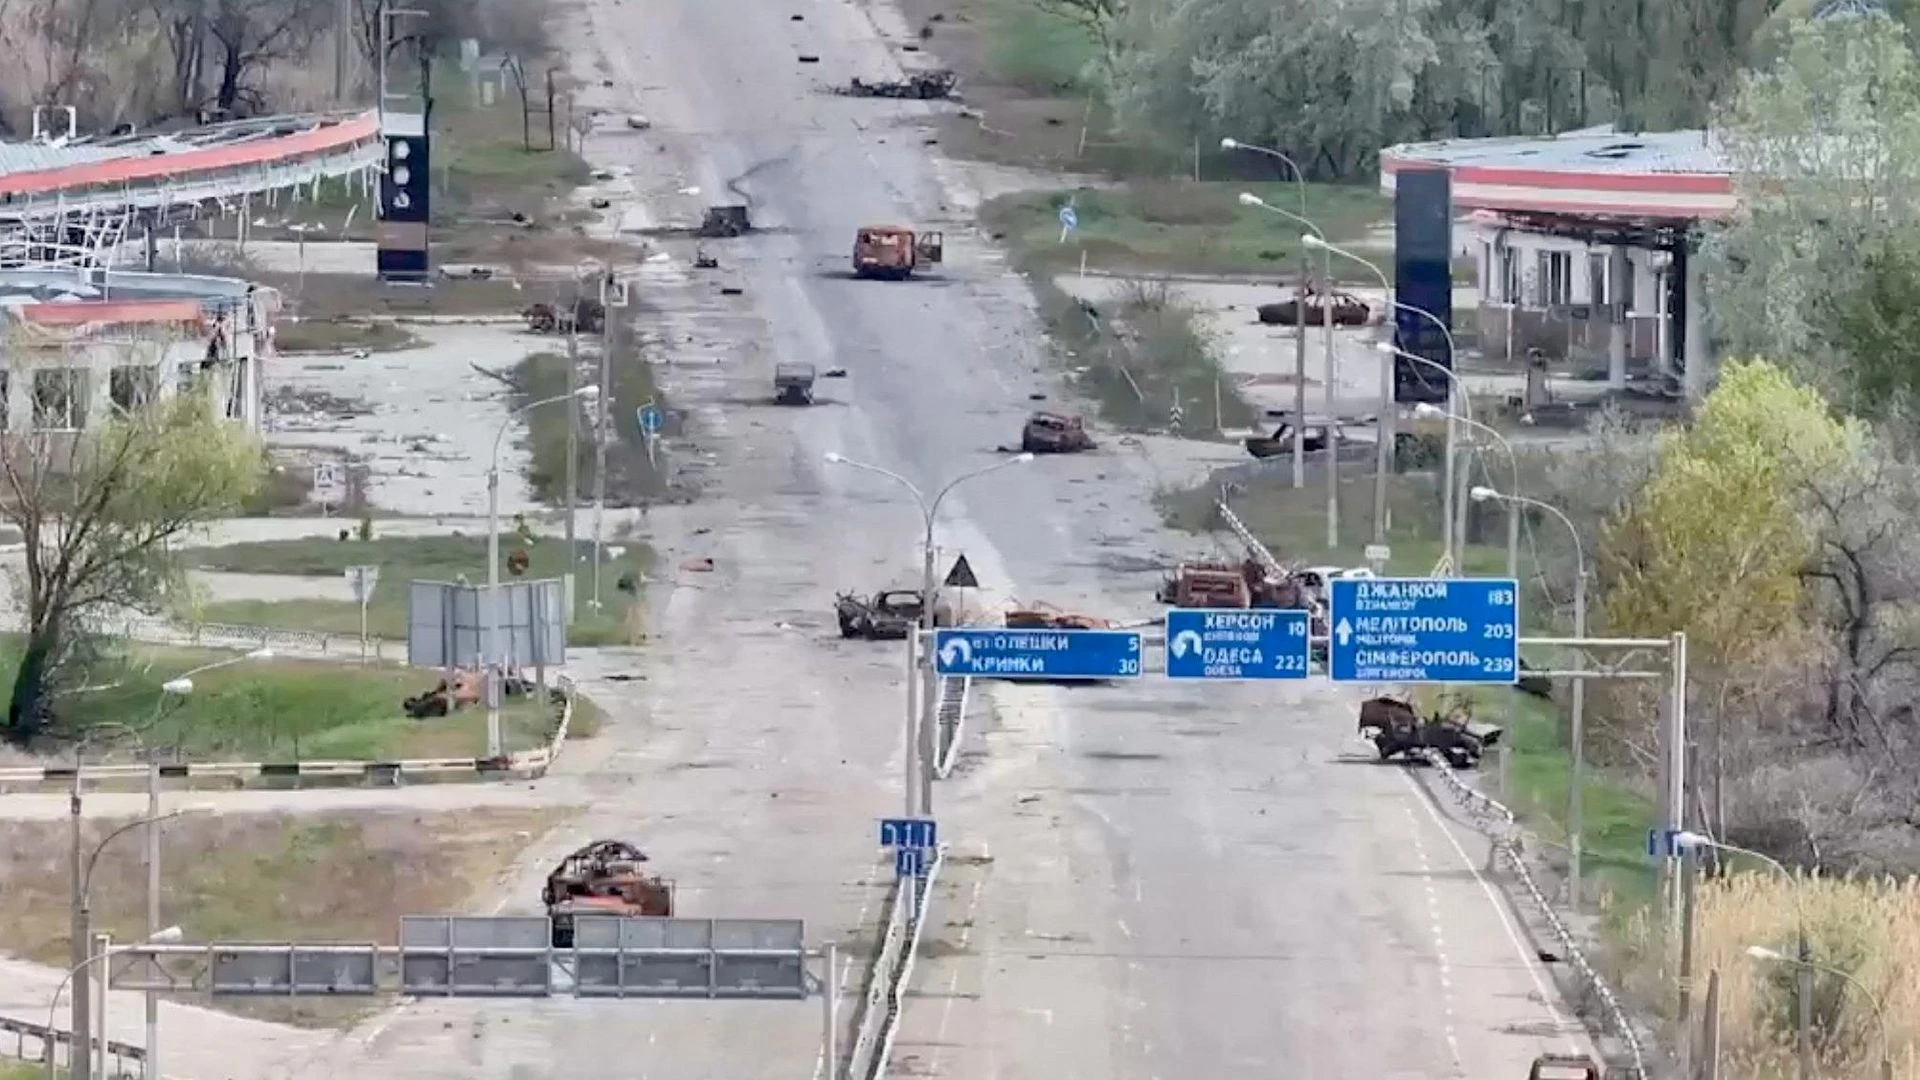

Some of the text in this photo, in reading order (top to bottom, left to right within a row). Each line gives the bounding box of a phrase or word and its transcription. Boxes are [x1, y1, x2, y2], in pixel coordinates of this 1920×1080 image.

[1356, 583, 1513, 605] ДЖАНКОЙ 183
[1204, 613, 1306, 636] ХЕРСОН 10
[1355, 617, 1513, 639] МЕЛІТОПОЛЬ 203
[1128, 637, 1139, 651] 5
[972, 656, 1138, 674] КРИНКИ 30
[1203, 647, 1305, 670] ОДЕСА 222
[1355, 651, 1513, 672] СІМФЕРОПОЛЬ 239
